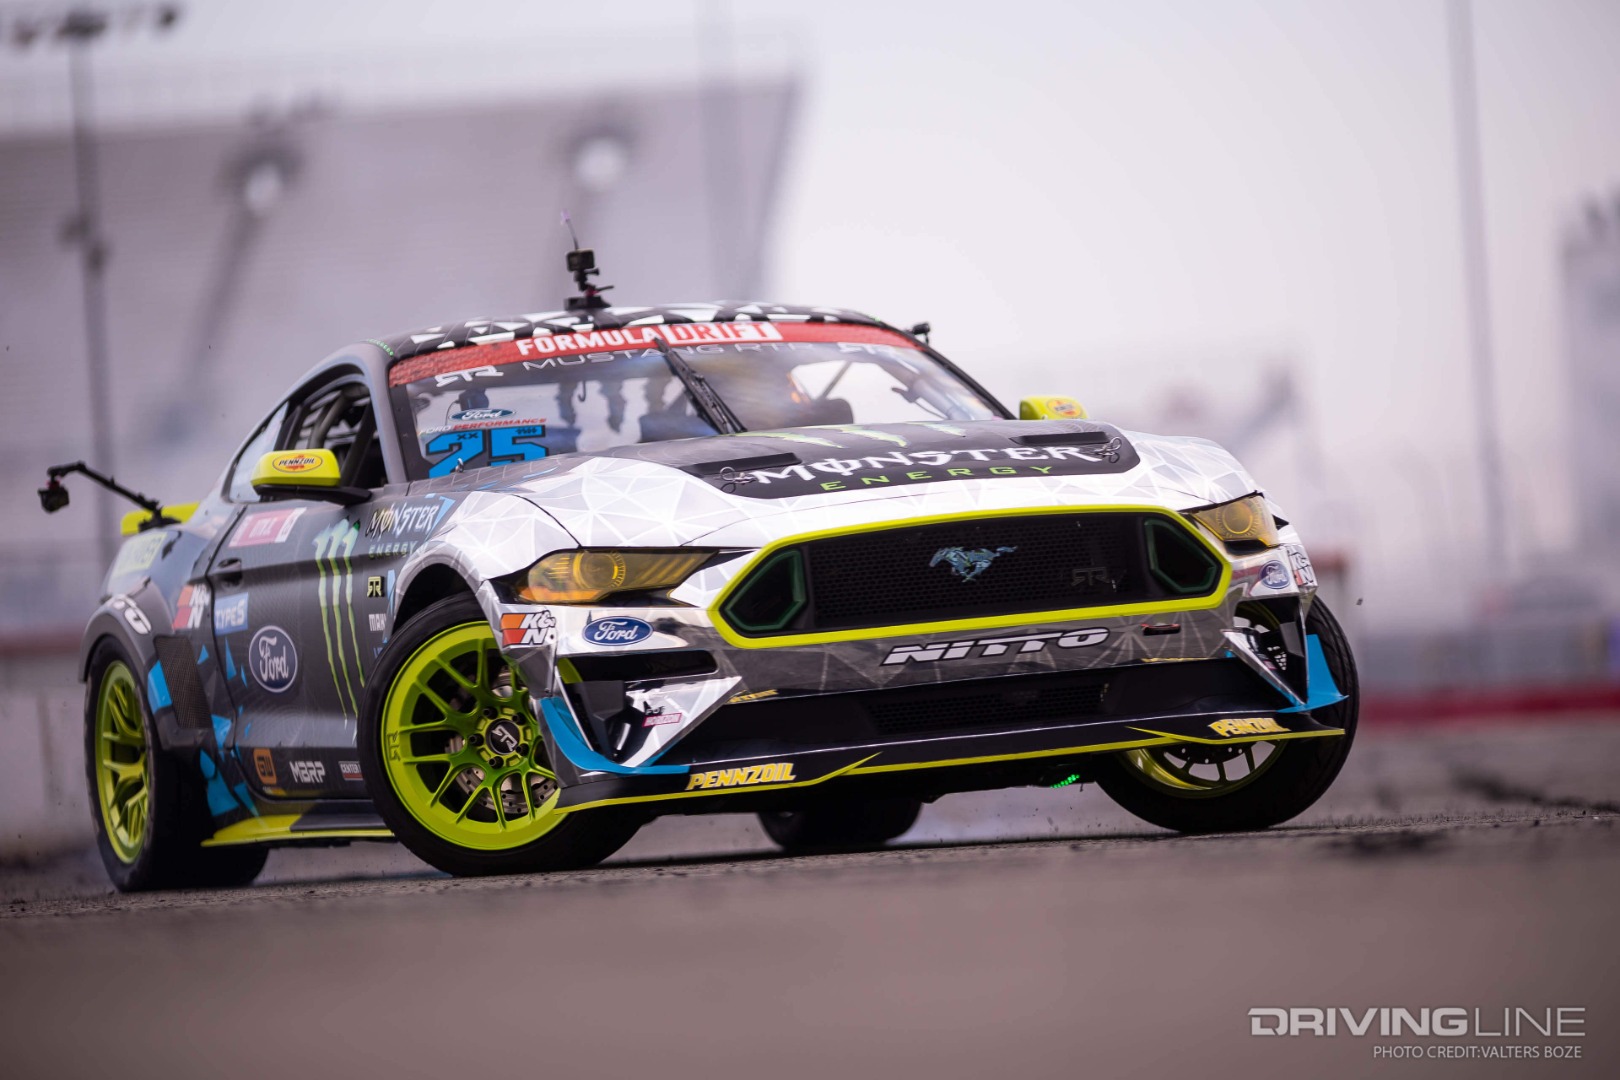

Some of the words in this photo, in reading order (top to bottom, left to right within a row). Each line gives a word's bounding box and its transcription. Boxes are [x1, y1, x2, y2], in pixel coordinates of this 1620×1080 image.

[516, 326, 664, 356] FORMULA
[669, 323, 770, 342] DRIFT
[461, 408, 502, 420] Ford
[278, 457, 315, 467] PENNZOIL
[425, 424, 549, 479] 25
[757, 446, 1106, 485] MONSTER
[820, 466, 1054, 491] ENERGY
[365, 502, 441, 541] MONSTER
[368, 541, 419, 559] ENERGY
[594, 621, 638, 641] Ford
[258, 635, 290, 682] Ford
[879, 627, 1110, 666] NITTO
[288, 760, 326, 783] MBRP
[684, 762, 797, 791] PENNZOIL
